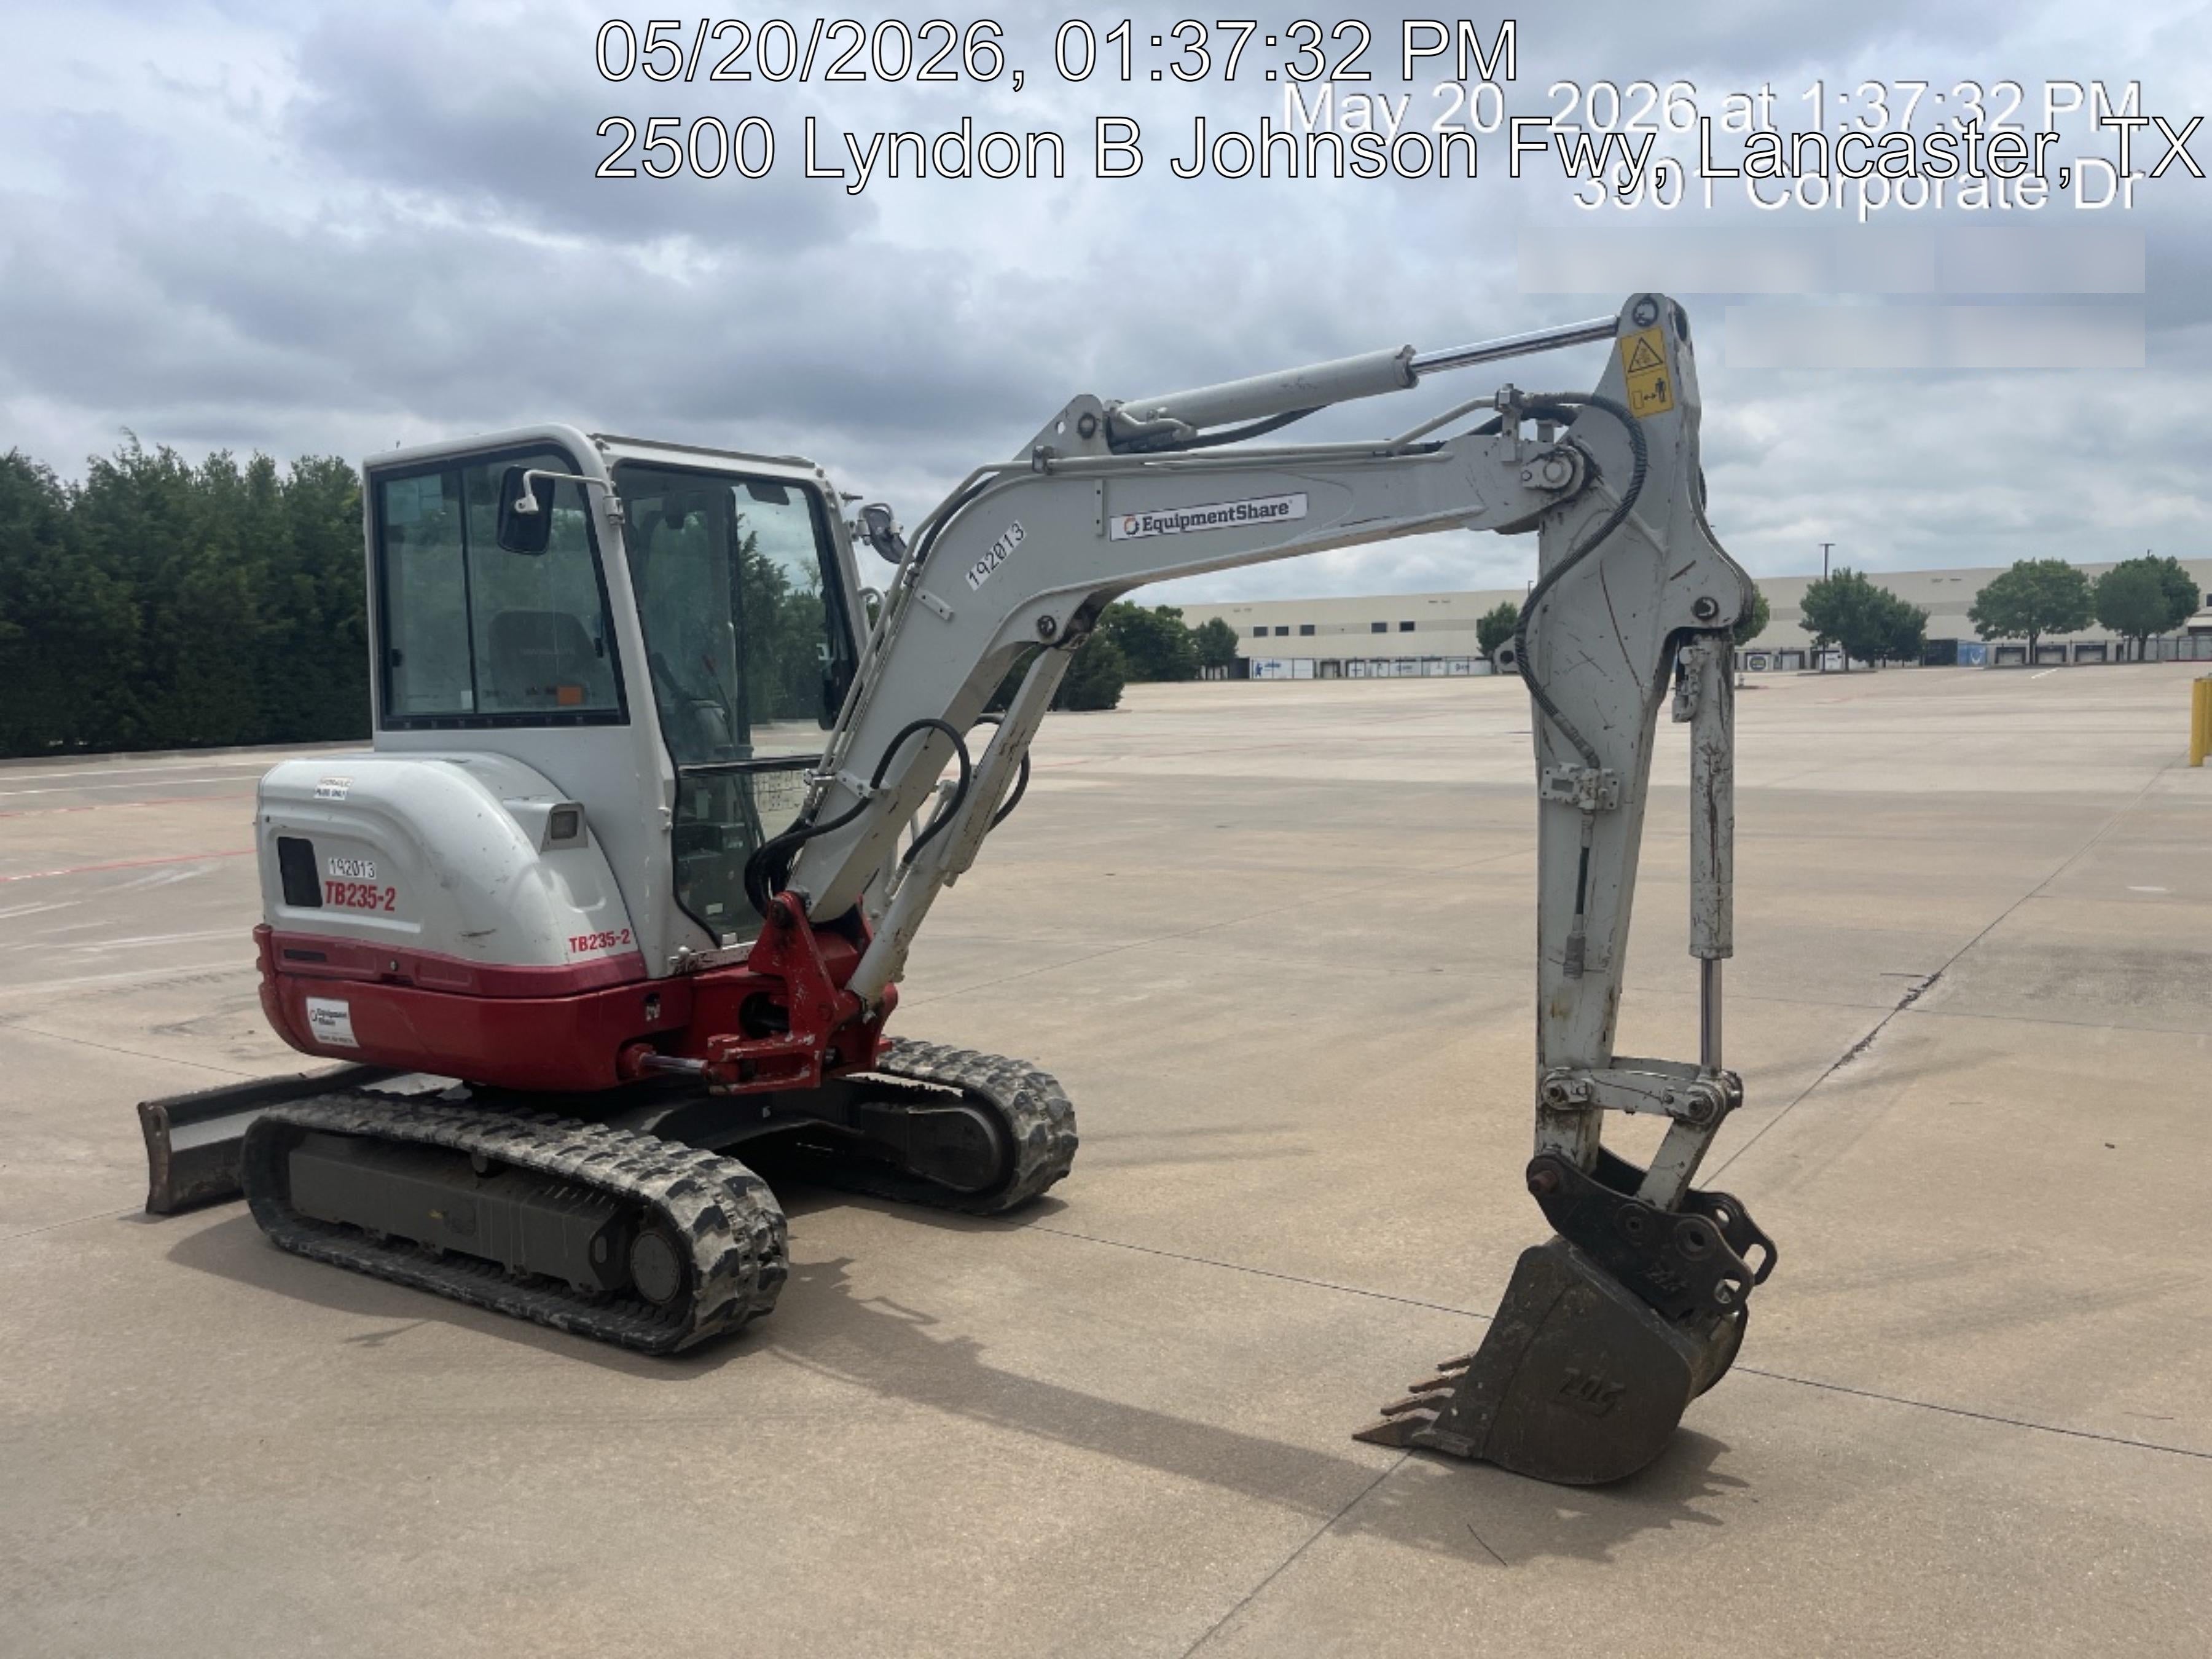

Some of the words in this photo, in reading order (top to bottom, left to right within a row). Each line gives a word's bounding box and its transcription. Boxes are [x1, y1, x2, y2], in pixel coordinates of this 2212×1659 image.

[1143, 502, 1289, 533] EquipmentShare
[968, 523, 1024, 586] 192013
[329, 858, 375, 878] 192013
[325, 880, 396, 911] TB235-2
[569, 928, 631, 954] TB235-2
